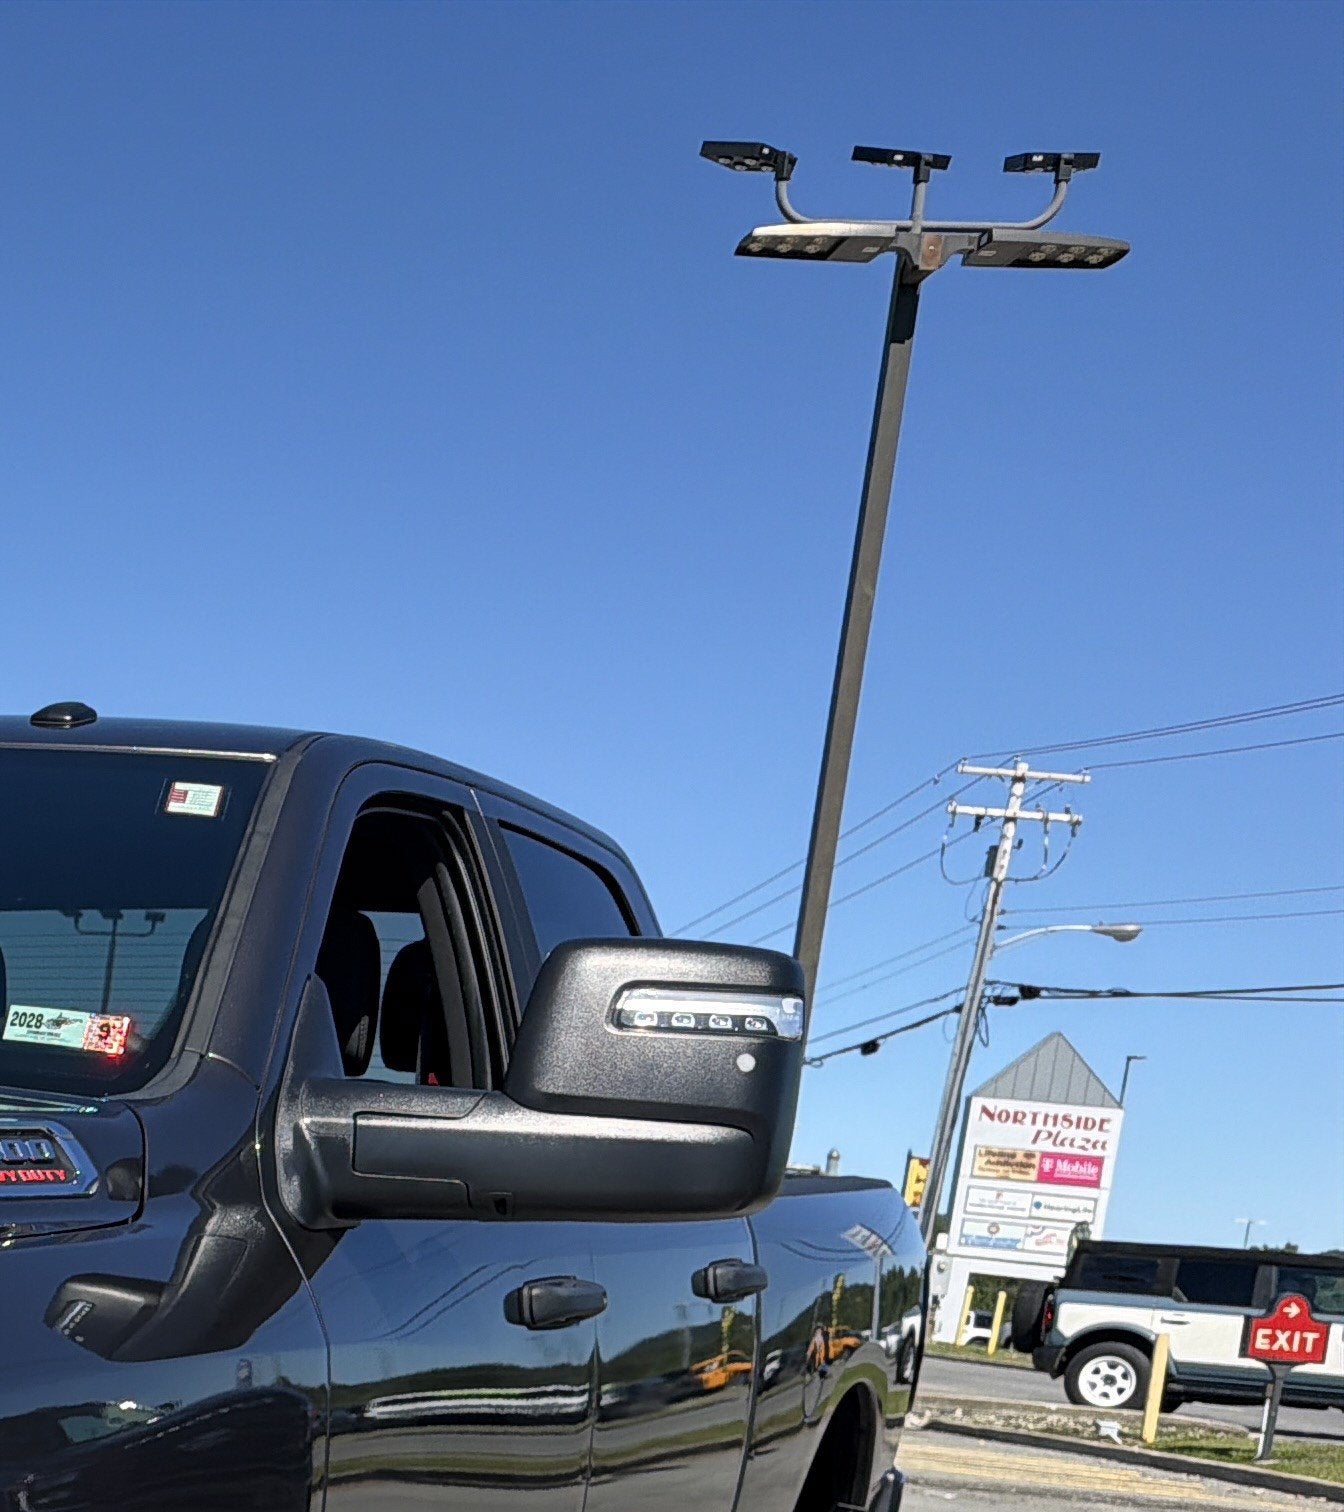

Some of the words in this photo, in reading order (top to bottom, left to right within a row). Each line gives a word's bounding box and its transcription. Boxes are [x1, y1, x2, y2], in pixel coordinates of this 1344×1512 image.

[9, 1011, 44, 1029] 2028
[978, 1104, 1113, 1133] NORTHSIDE
[1031, 1129, 1108, 1151] Plaza
[18, 1169, 67, 1182] DUTY
[1254, 1328, 1321, 1353] EXIT
